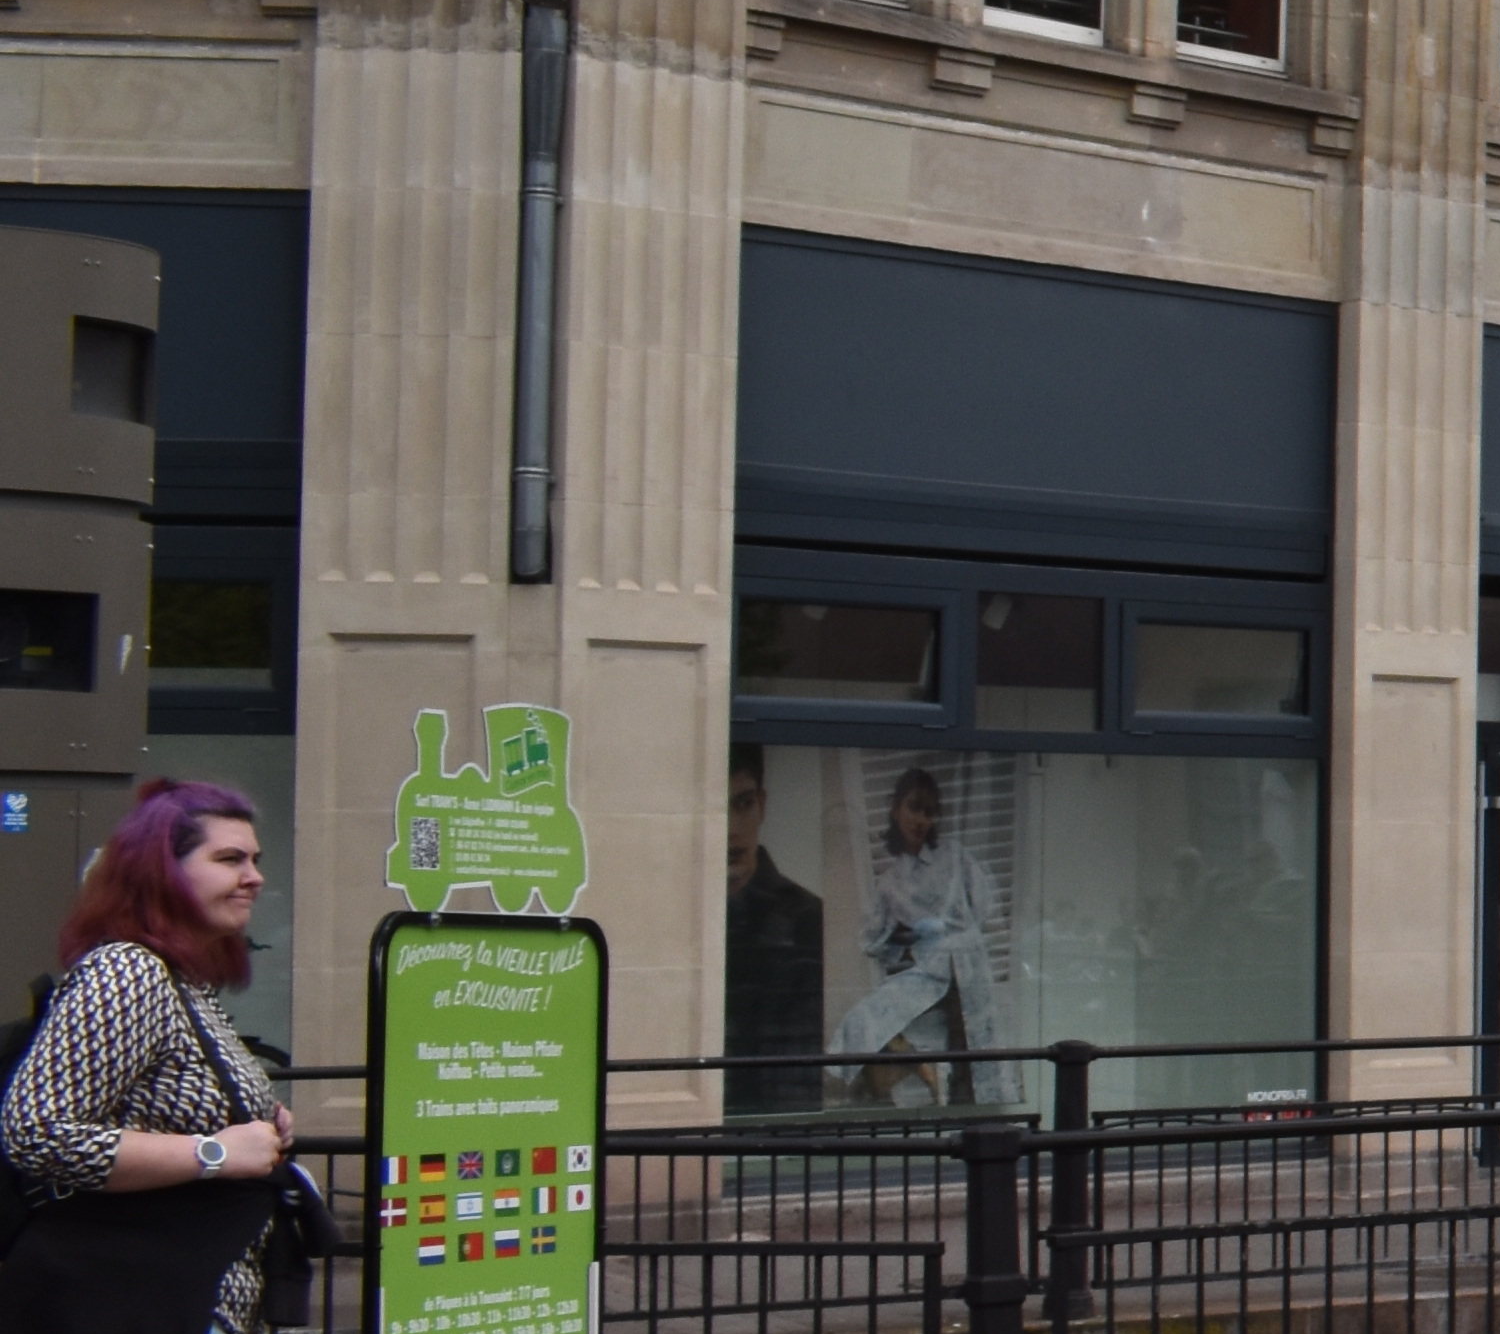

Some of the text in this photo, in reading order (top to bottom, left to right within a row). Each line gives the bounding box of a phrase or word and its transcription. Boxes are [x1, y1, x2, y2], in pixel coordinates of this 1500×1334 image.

[396, 937, 589, 975] Découvrez la VIEILLE VILLE
[433, 989, 450, 1008] en
[543, 986, 552, 1010] !
[418, 1042, 450, 1059] Maison
[453, 1042, 469, 1059] des
[502, 1041, 533, 1057] Maison
[416, 1100, 424, 1117] 3
[426, 1100, 453, 1116] Trains
[456, 1102, 476, 1115] avec
